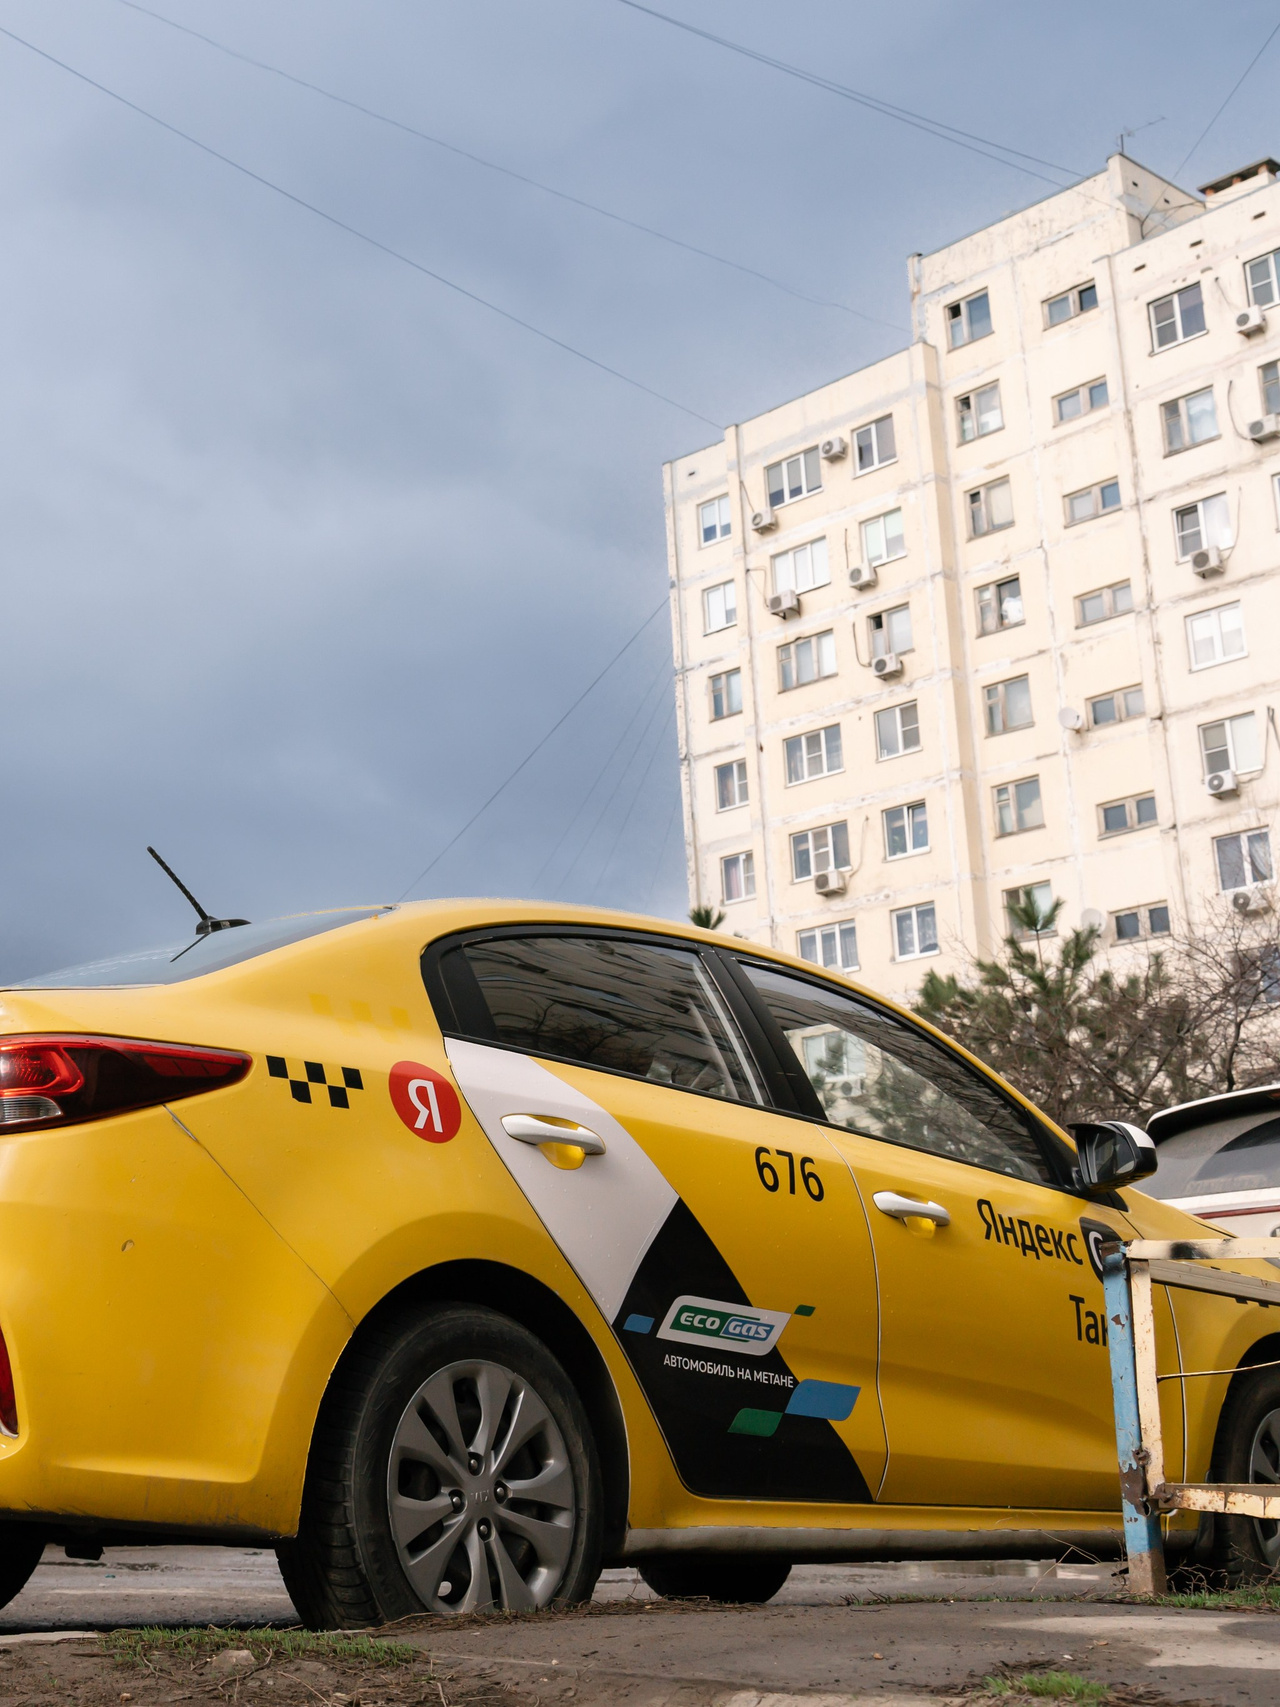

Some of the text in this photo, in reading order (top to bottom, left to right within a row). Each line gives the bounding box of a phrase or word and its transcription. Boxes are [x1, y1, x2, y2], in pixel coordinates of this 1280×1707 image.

[407, 1078, 443, 1133] Я
[754, 1146, 825, 1202] 676
[976, 1198, 1084, 1266] Яндекс
[663, 1353, 794, 1389] АВТОМОБИЛЬ НА МЕТАНЕ
